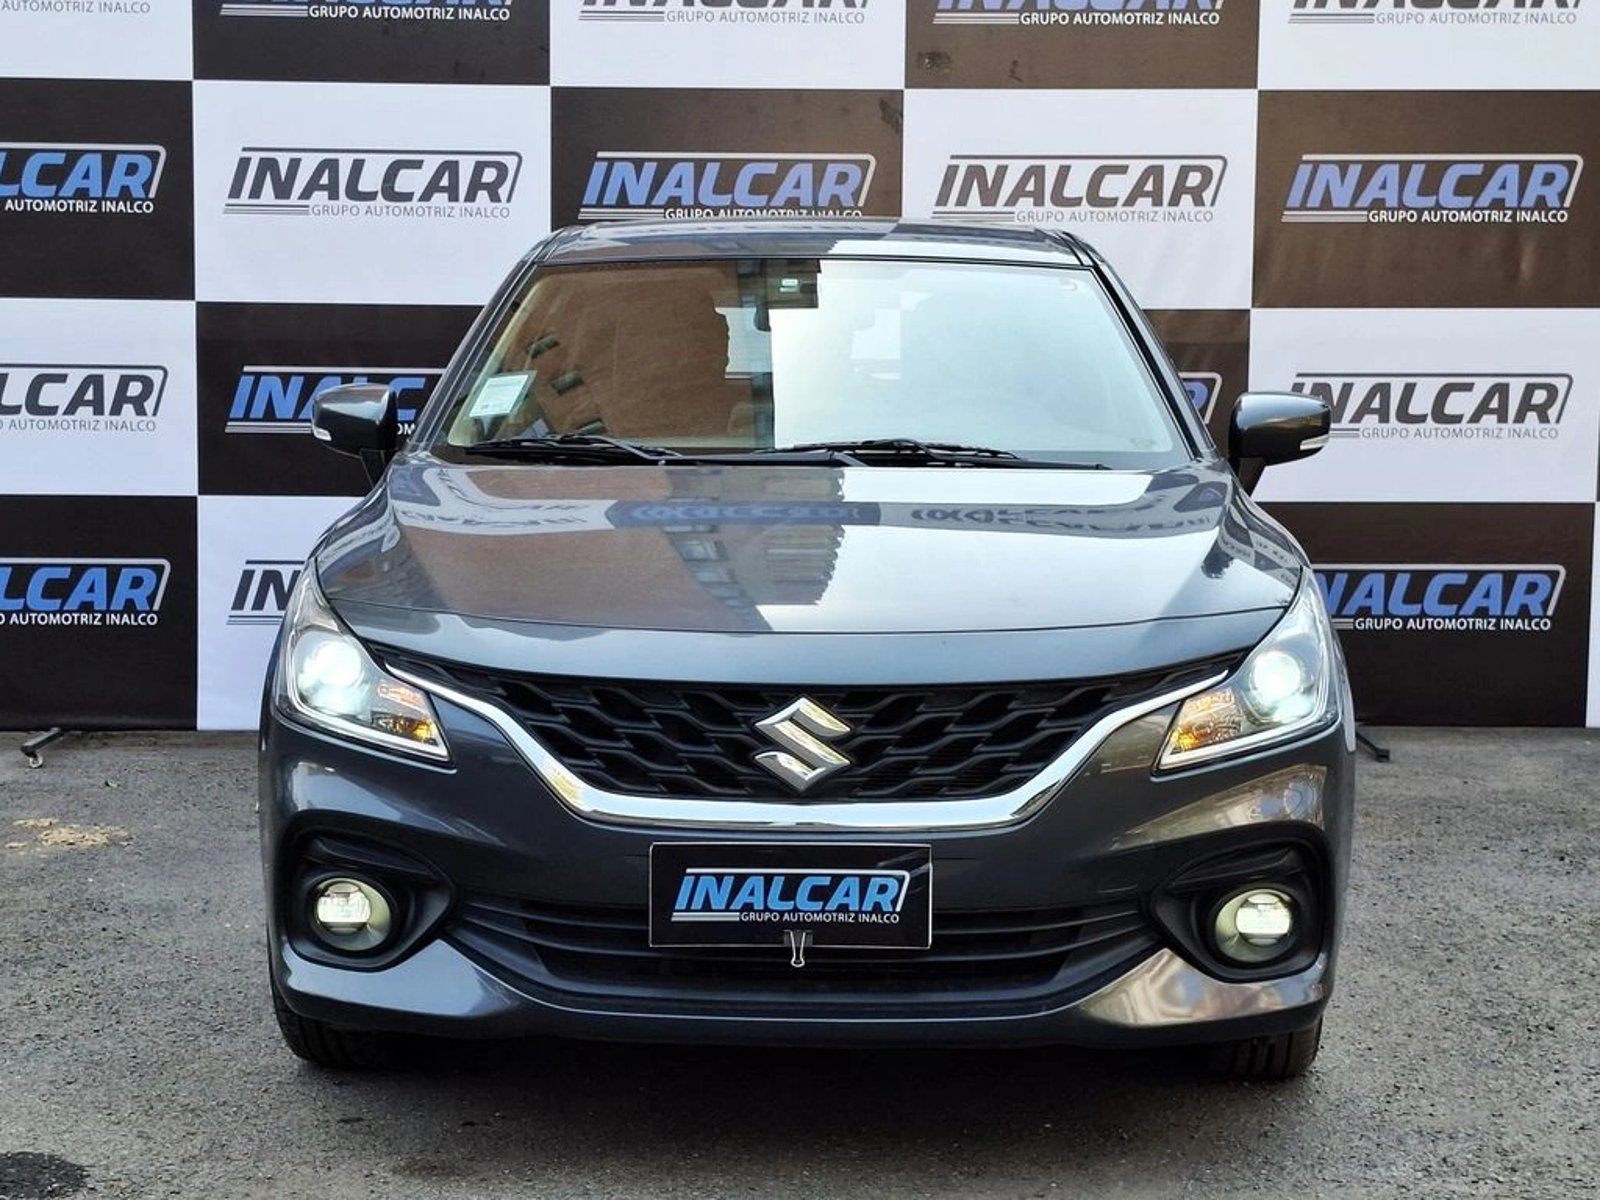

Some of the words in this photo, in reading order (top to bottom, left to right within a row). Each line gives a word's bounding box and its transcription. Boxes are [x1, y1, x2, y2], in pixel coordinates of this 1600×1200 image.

[1, 0, 94, 13] AUTOMOTRIZ
[98, 1, 151, 14] INALCO
[309, 5, 359, 18] GRUPO
[362, 6, 455, 20] AUTOMOTRIZ
[458, 8, 511, 21] INALCO
[666, 11, 716, 23] GRUPO
[719, 11, 810, 24] AUTOMOTRIZ
[813, 12, 865, 25] INALCO
[1020, 12, 1070, 25] GRUPO
[1073, 12, 1164, 26] AUTOMOTRIZ
[1168, 12, 1220, 26] INALCO
[1376, 13, 1426, 25] GRUPO
[1429, 13, 1521, 25] AUTOMOTRIZ
[1524, 13, 1577, 25] INALCO
[227, 157, 509, 203] INALCAR
[582, 161, 863, 207] INALCAR
[935, 164, 1214, 208] INALCAR
[1285, 163, 1570, 209] INALCAR
[4, 199, 98, 213] AUTOMOTRIZ
[101, 200, 154, 214] INALCO
[311, 203, 361, 217] GRUPO
[364, 204, 455, 218] AUTOMOTRIZ
[459, 206, 511, 219] INALCO
[665, 208, 714, 219] GRUPO
[1016, 210, 1066, 223] GRUPO
[1068, 210, 1160, 223] AUTOMOTRIZ
[1163, 210, 1214, 223] INALCO
[1368, 210, 1418, 223] GRUPO
[1422, 210, 1513, 223] AUTOMOTRIZ
[1516, 210, 1568, 223] INALCO
[1291, 382, 1559, 424] NALCAR
[9, 419, 101, 431] AUTOMOTRIZ
[105, 420, 157, 432] INALCO
[1361, 427, 1410, 440] GRUPO
[1413, 427, 1503, 440] AUTOMOTRIZ
[1507, 427, 1559, 440] INALCO
[1314, 572, 1552, 616] NALCAR
[9, 612, 102, 625] AUTOMOTRIZ
[106, 613, 158, 626] INALCO
[1355, 618, 1403, 631] GRUPO
[1406, 618, 1496, 631] AUTOMOTRIZ
[1500, 618, 1551, 631] INALCO
[674, 875, 900, 912] INALCAR
[741, 911, 780, 922] GRUPO
[782, 912, 855, 923] AUTOMOTRIZ
[858, 913, 900, 924] INALCO
